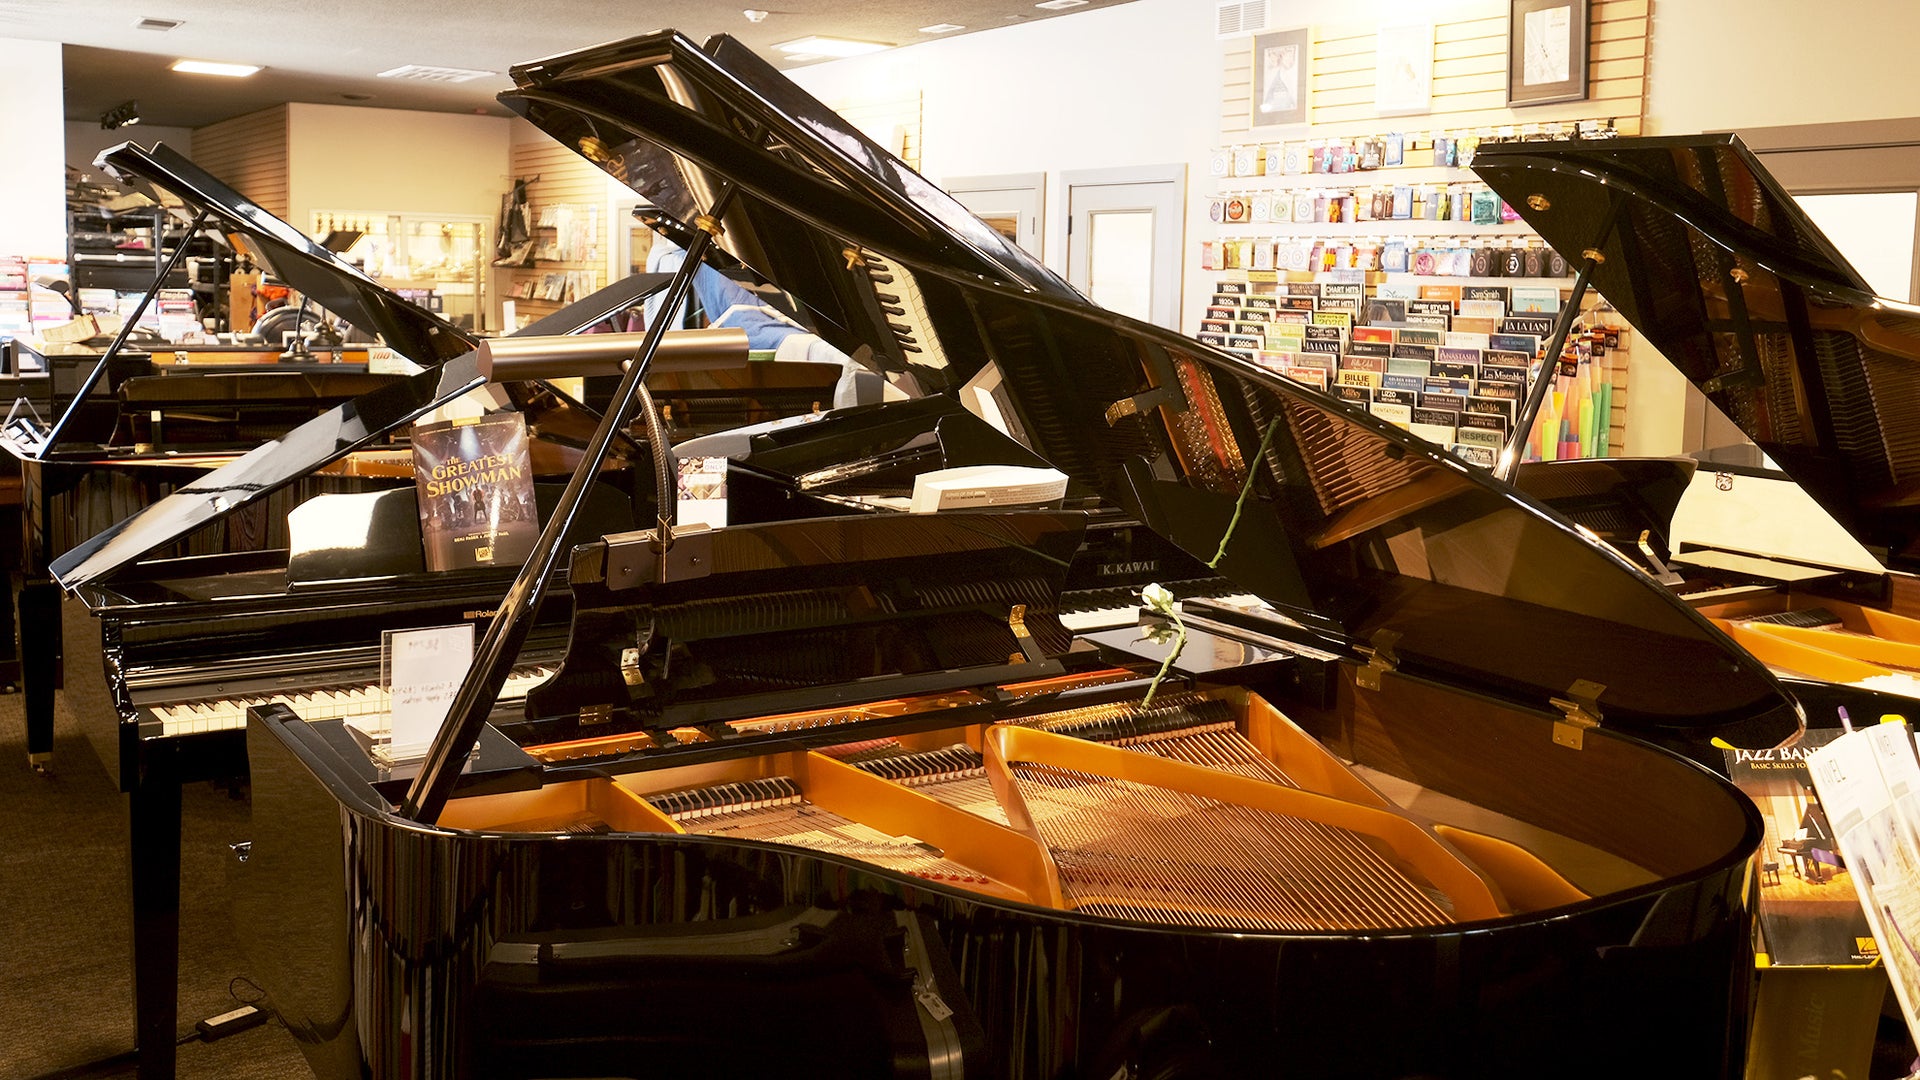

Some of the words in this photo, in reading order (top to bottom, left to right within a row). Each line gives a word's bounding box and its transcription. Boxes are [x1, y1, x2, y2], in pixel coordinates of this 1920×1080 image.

[1326, 286, 1344, 294] CHART
[1345, 286, 1359, 295] HITS
[1471, 289, 1484, 299] Sam
[1484, 290, 1500, 299] Smith
[1321, 300, 1339, 308] CHART
[1340, 300, 1355, 309] HITS
[1234, 339, 1253, 348] 2000s
[1440, 350, 1477, 361] ANASTASIA
[1345, 374, 1370, 382] BILLIE
[1460, 431, 1498, 442] RESPECT
[432, 453, 515, 480] GREATEST
[426, 466, 522, 499] SHOWMAN
[475, 610, 499, 619] Rolan
[1735, 749, 1775, 765] JAZZ
[1780, 747, 1820, 761] BAN
[1750, 762, 1771, 770] BASIC
[1773, 762, 1795, 770] SKILLS
